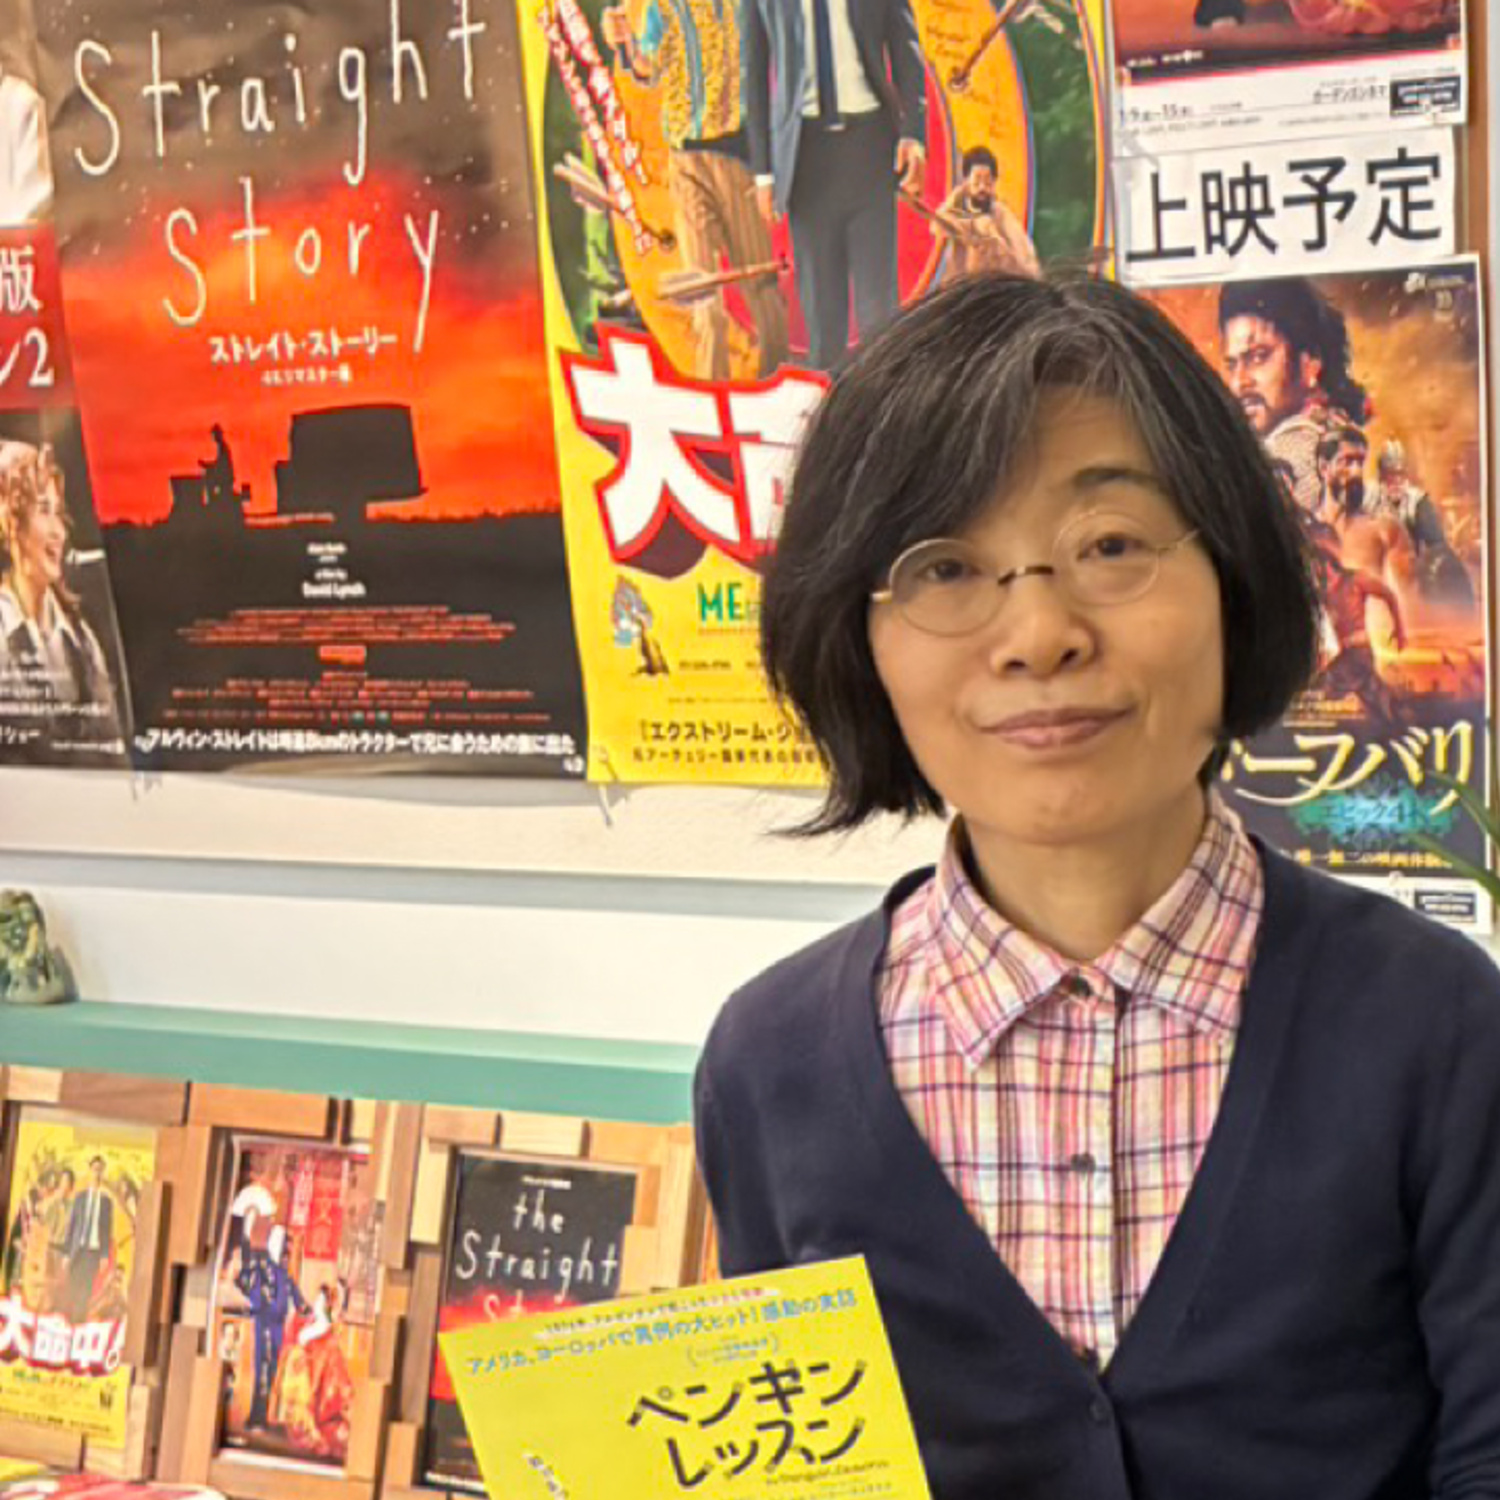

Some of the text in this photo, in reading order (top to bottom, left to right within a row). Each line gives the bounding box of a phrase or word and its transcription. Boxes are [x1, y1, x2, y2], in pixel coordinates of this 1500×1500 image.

[75, 0, 485, 186] Straight
[1125, 147, 1442, 263] 上映予定
[164, 177, 439, 352] Story
[513, 1189, 564, 1233] the
[456, 1229, 618, 1304] Straight
[627, 1360, 867, 1428] ペンギン
[667, 1417, 866, 1488] レッスン
